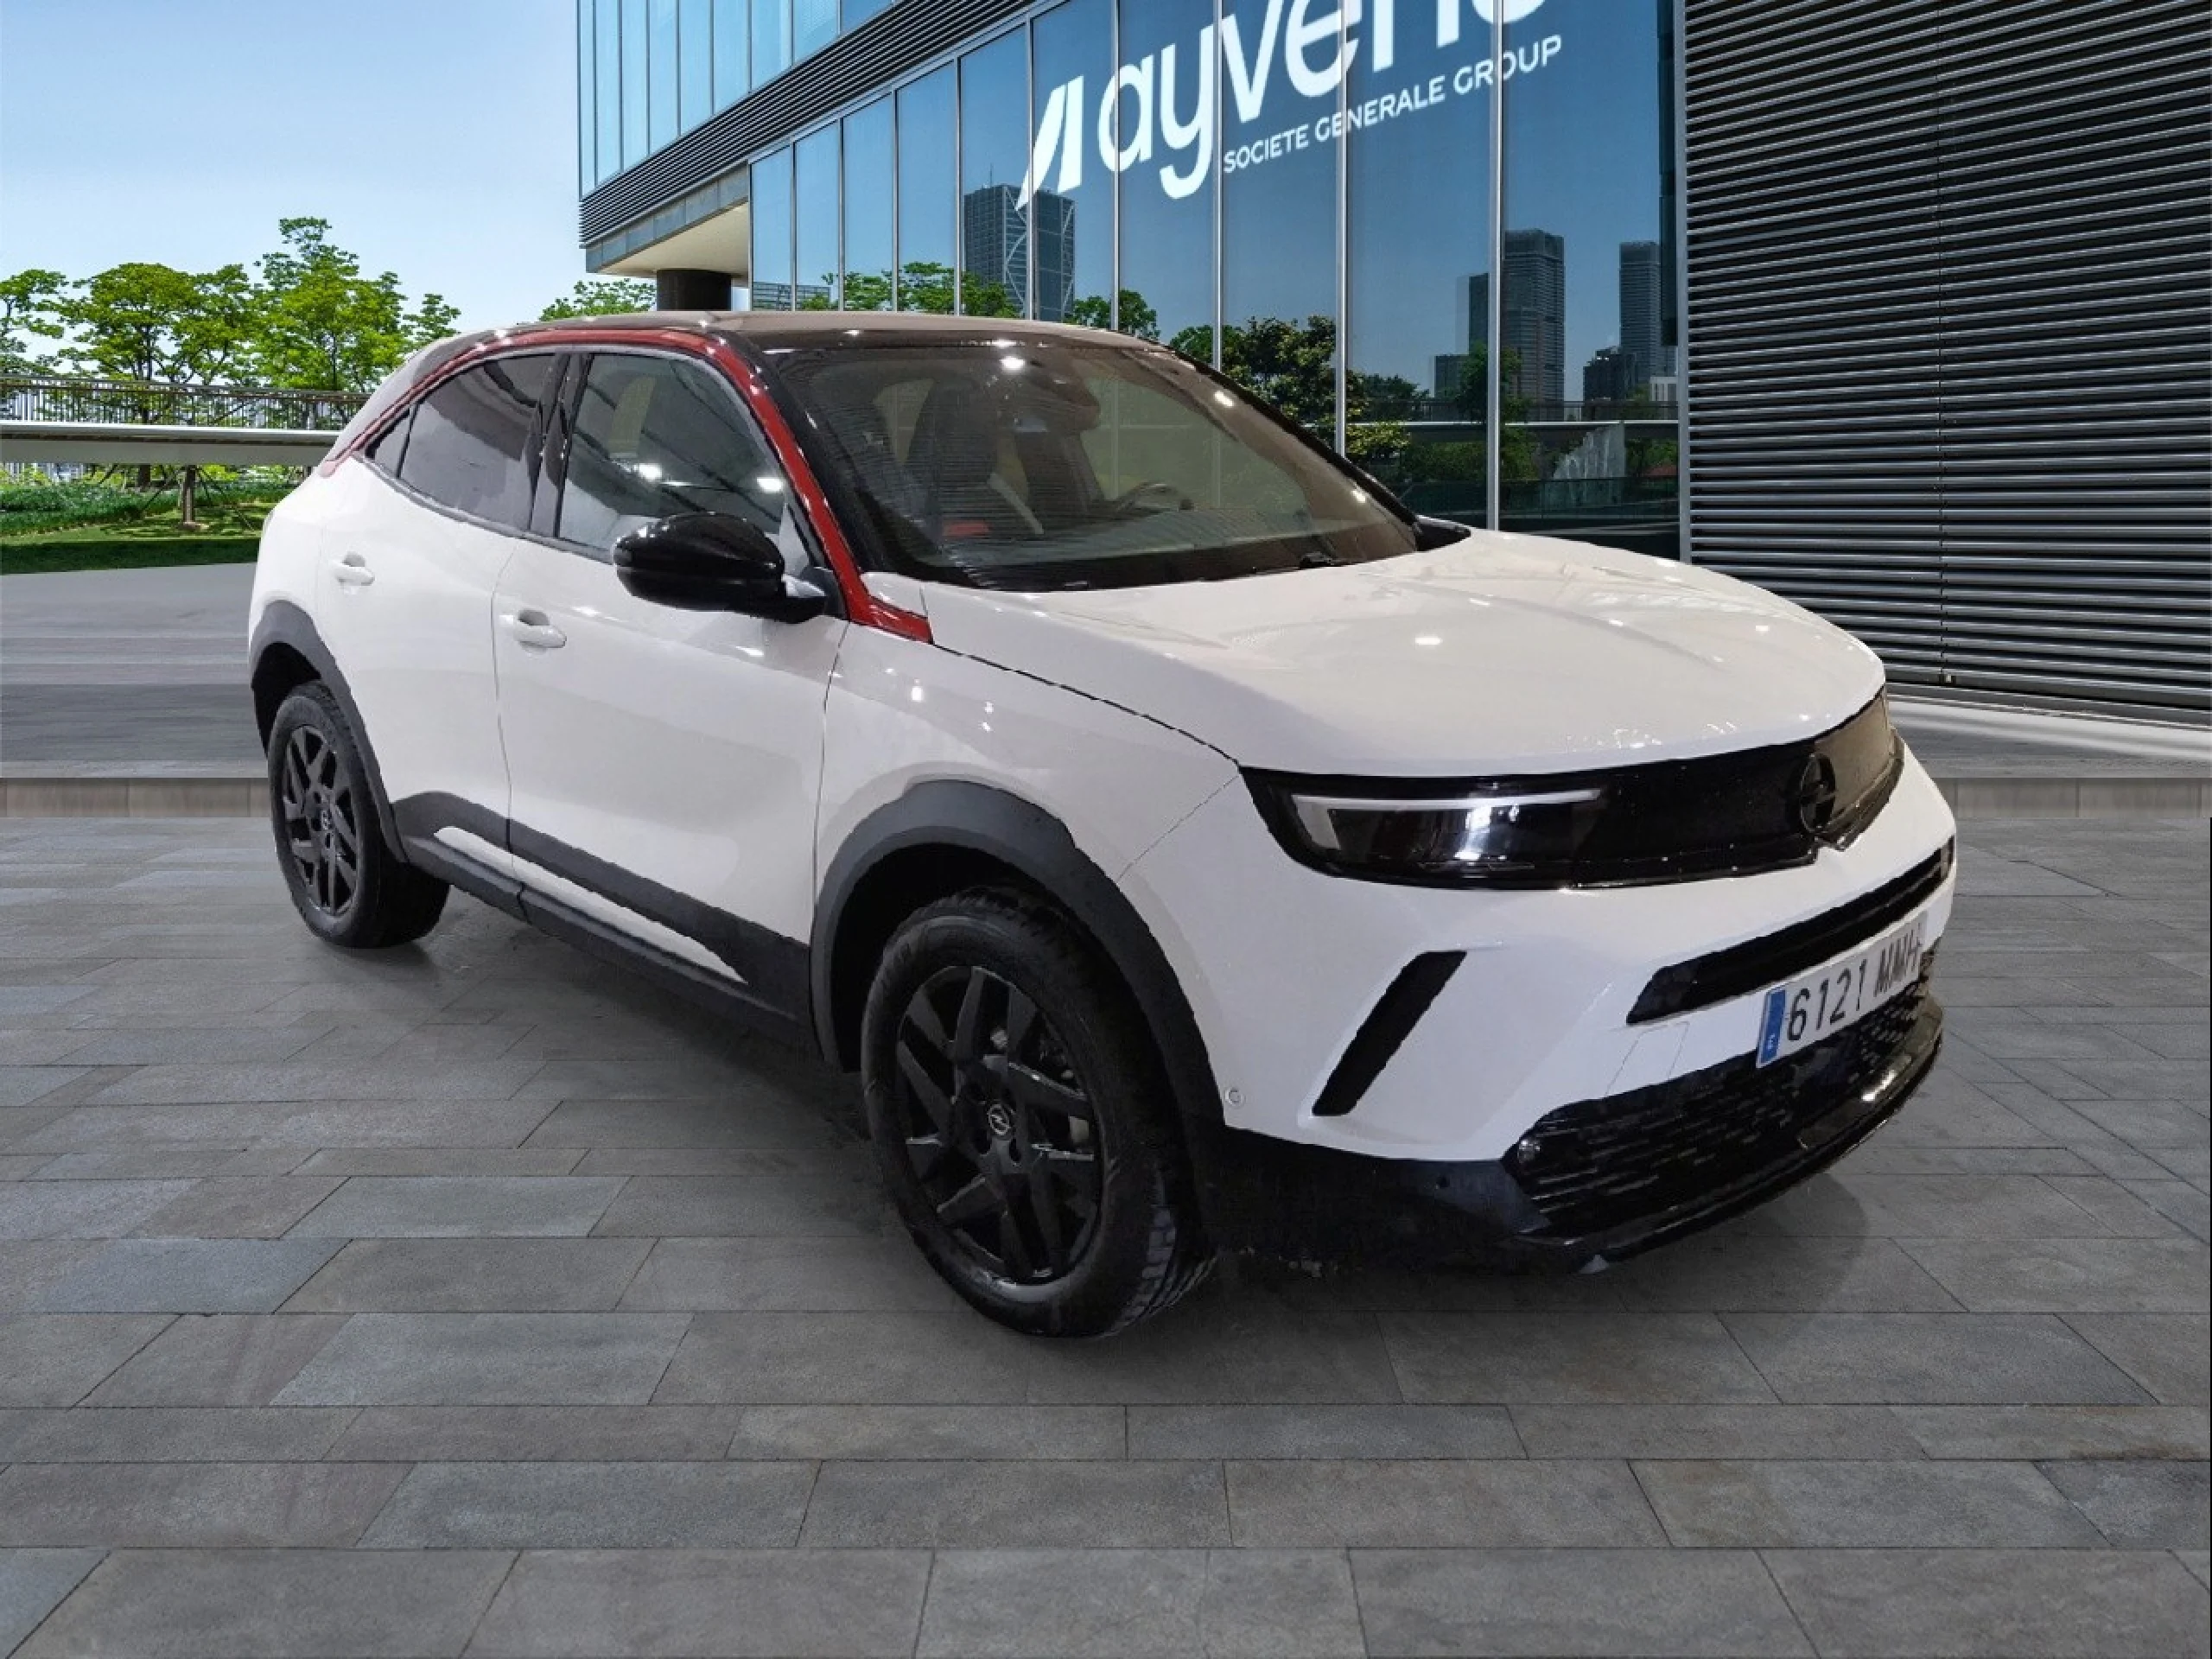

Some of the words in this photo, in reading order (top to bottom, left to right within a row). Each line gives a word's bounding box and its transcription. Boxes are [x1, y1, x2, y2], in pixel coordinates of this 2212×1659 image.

[1097, 0, 1547, 199] ayven
[1223, 124, 1310, 174] SOCIETE
[1314, 74, 1446, 143] GENERALE
[1452, 34, 1561, 96] GROUP
[1787, 958, 1867, 1041] 6121
